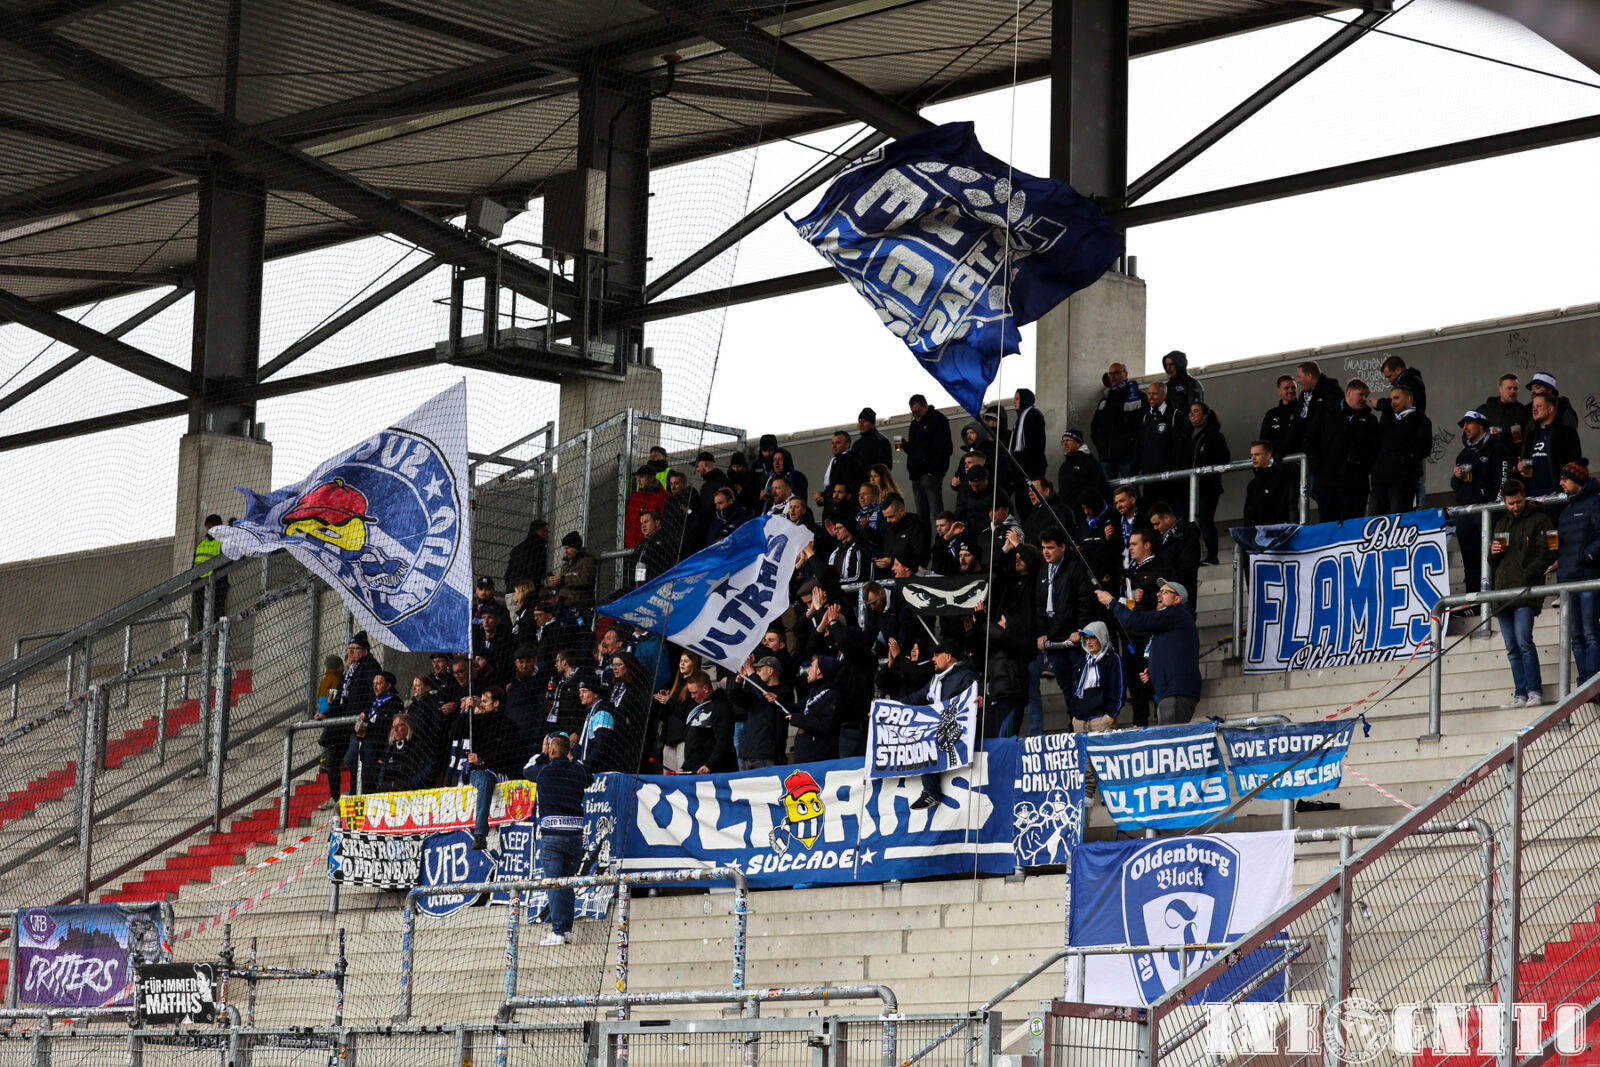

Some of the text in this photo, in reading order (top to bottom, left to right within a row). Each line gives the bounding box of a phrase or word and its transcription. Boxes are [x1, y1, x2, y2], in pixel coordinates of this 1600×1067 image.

[1358, 515, 1417, 552] Blue
[686, 533, 789, 660] ULTRAS
[1248, 541, 1446, 664] FLAMES
[875, 705, 914, 726] PRO
[876, 725, 928, 746] NEUES
[1025, 735, 1042, 753] NO
[1230, 731, 1350, 758] LOVE FOOTBALL
[876, 739, 938, 771] STADION
[1021, 749, 1078, 773] NO NAZIS
[1091, 742, 1219, 781] ENTOURAGE
[1022, 772, 1057, 792] ONLY
[1272, 761, 1341, 788] FASCISM
[636, 750, 995, 850] ULTRAS
[424, 842, 469, 887] VFB
[504, 853, 523, 872] THE
[745, 848, 855, 875] SUCCADE
[1130, 843, 1230, 880] Oldenburg
[1157, 866, 1204, 890] Block
[24, 952, 119, 1001] CRITTERS
[163, 978, 197, 993] IMMER
[145, 992, 202, 1015] MATHIS
